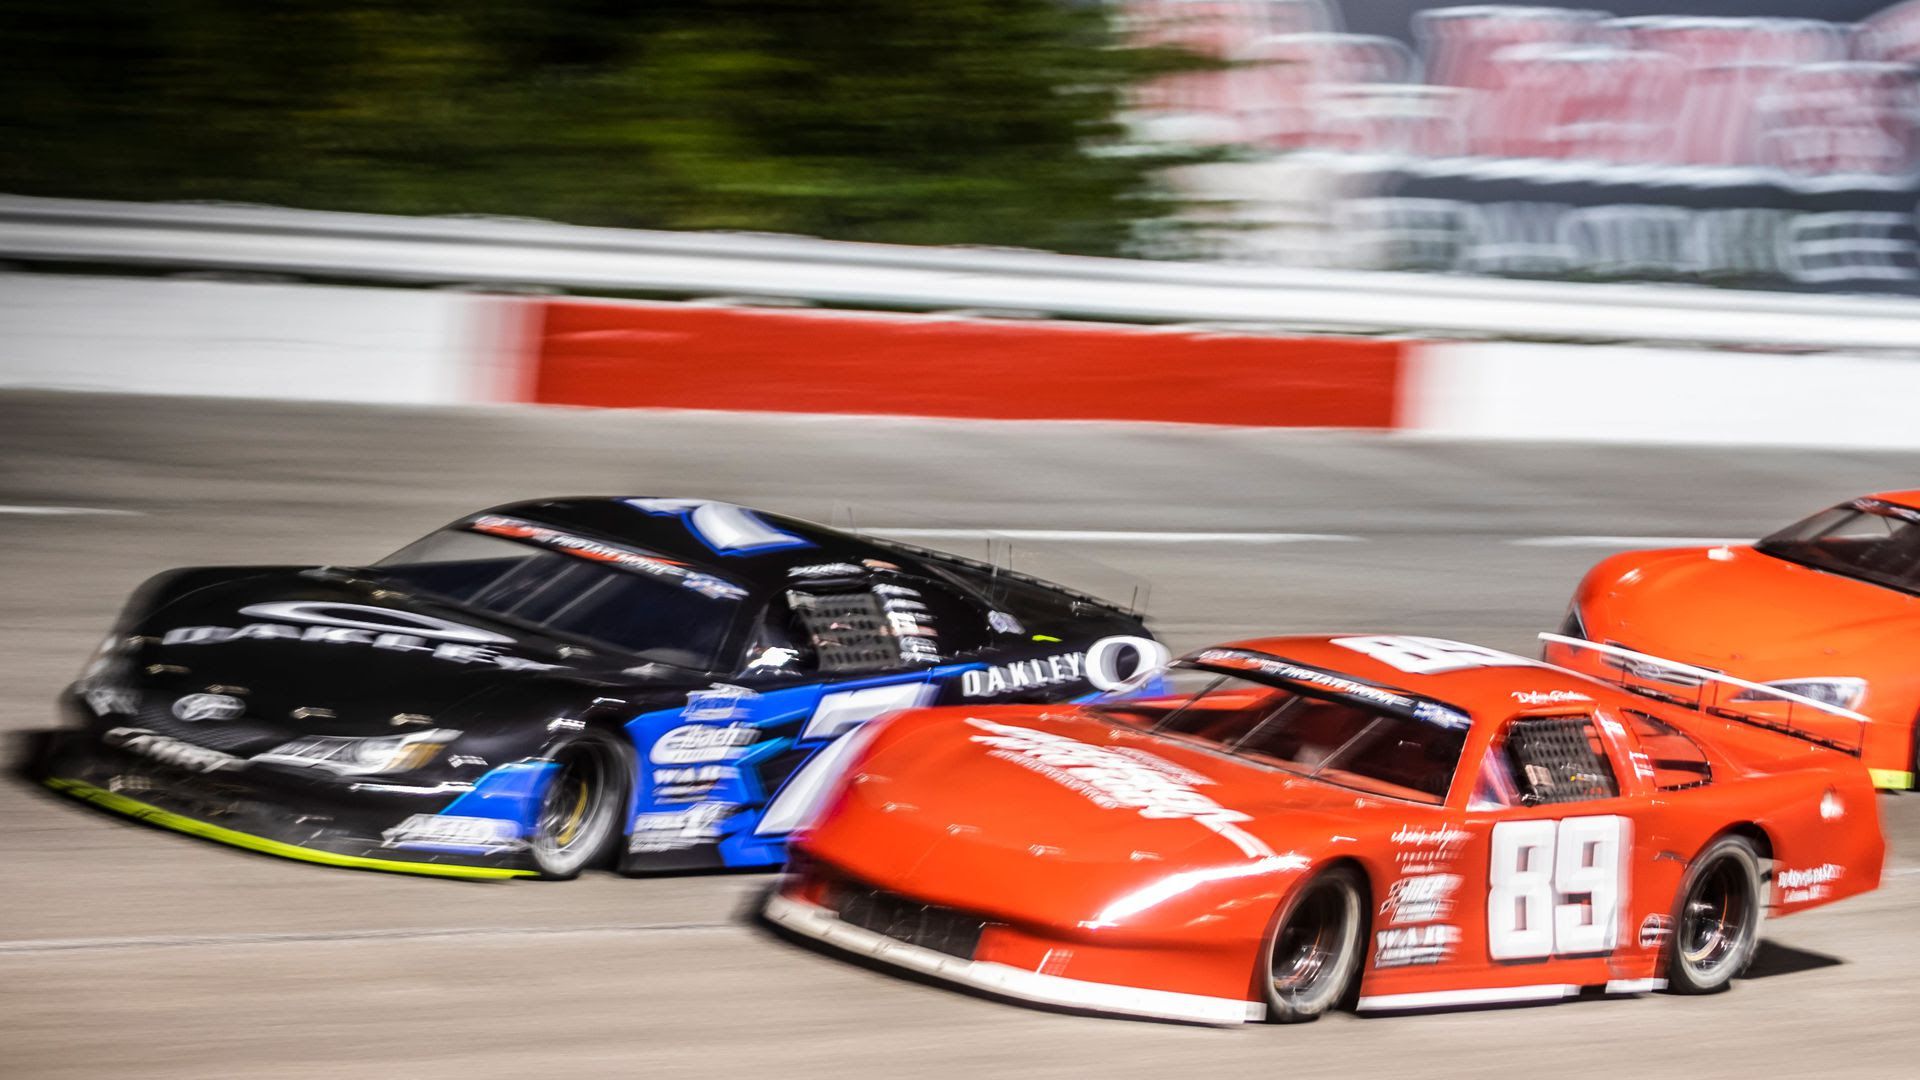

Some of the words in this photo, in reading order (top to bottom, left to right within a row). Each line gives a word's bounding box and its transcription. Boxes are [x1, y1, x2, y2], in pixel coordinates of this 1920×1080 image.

[623, 499, 808, 551] 7
[962, 651, 1083, 697] OAKLEY
[752, 682, 938, 835] 7
[1488, 814, 1632, 961] 89
